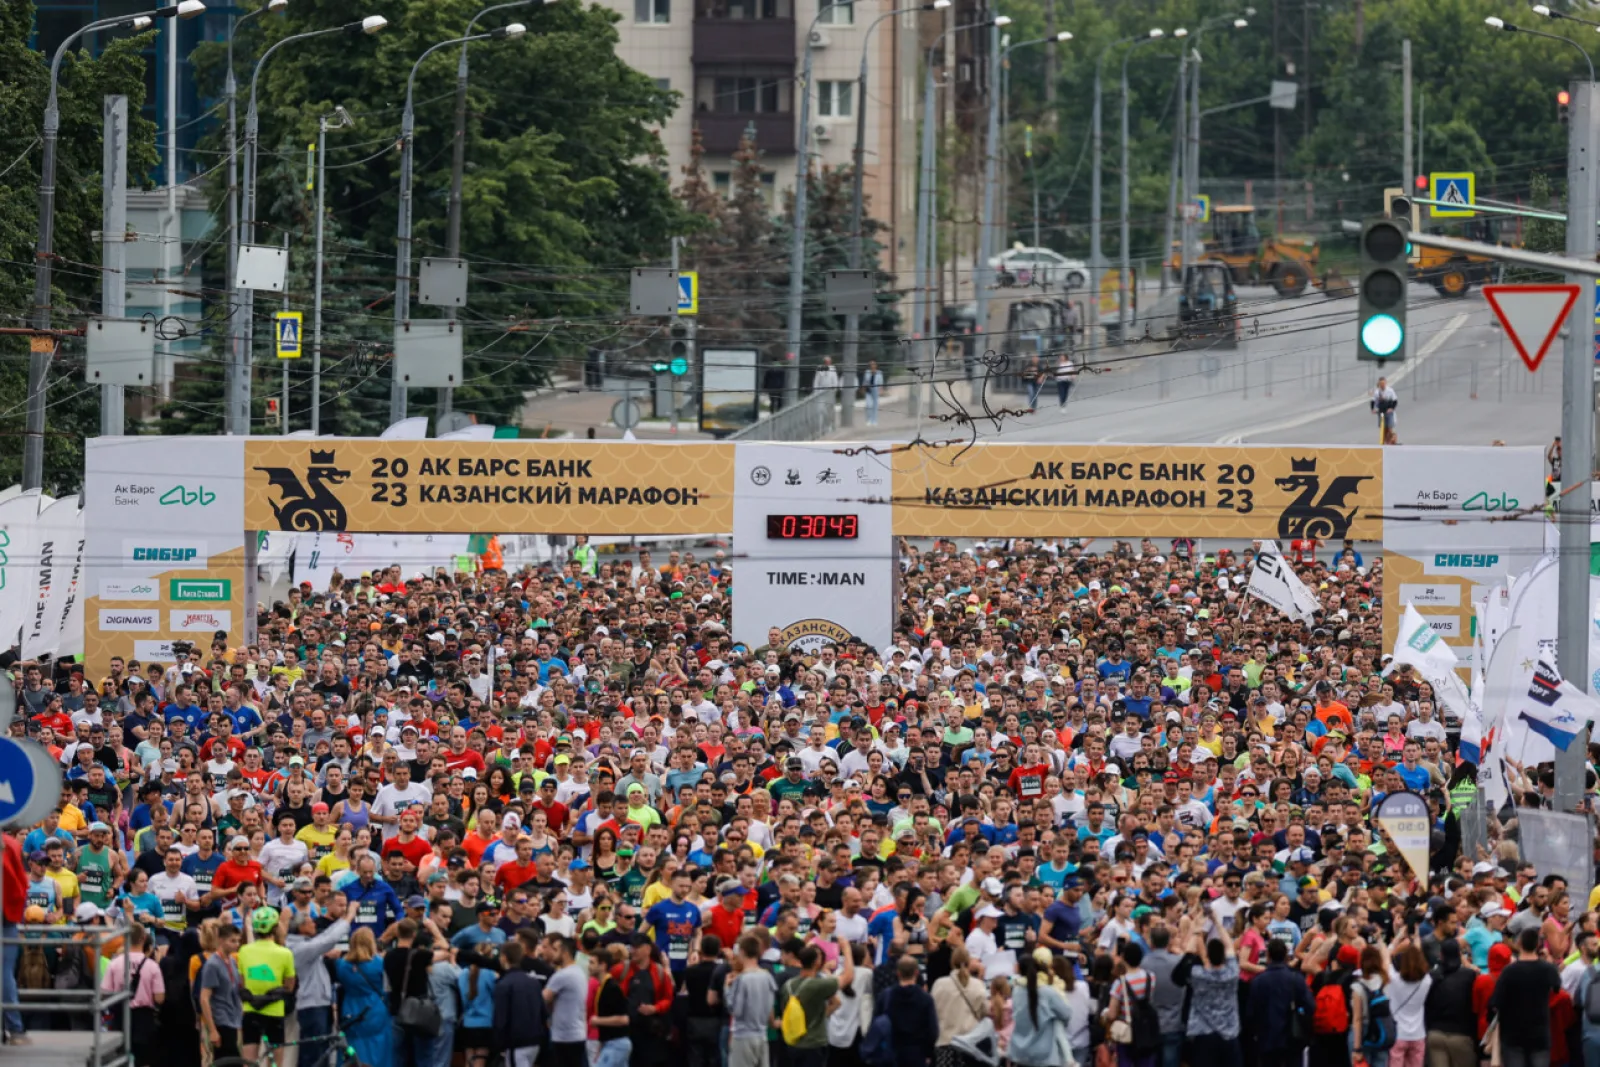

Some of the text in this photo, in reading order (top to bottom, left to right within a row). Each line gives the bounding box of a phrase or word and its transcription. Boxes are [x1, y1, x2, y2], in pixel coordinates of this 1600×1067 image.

[371, 457, 592, 478] 20 АК БАРС БАНК
[1030, 461, 1255, 485] АК БАРС БАНК 20
[114, 484, 155, 495] Ак Барс
[371, 482, 698, 507] 23 КАЗАНСКИЙ МАРАФОН
[1417, 490, 1458, 502] Ак Барс
[114, 496, 140, 506] Банк
[924, 484, 1254, 513] КАЗАНСКИЙ МАРАФОН 23
[133, 547, 197, 561] СИБУР
[1434, 553, 1499, 567] СИБУР
[105, 615, 153, 625] DIGINAVIS
